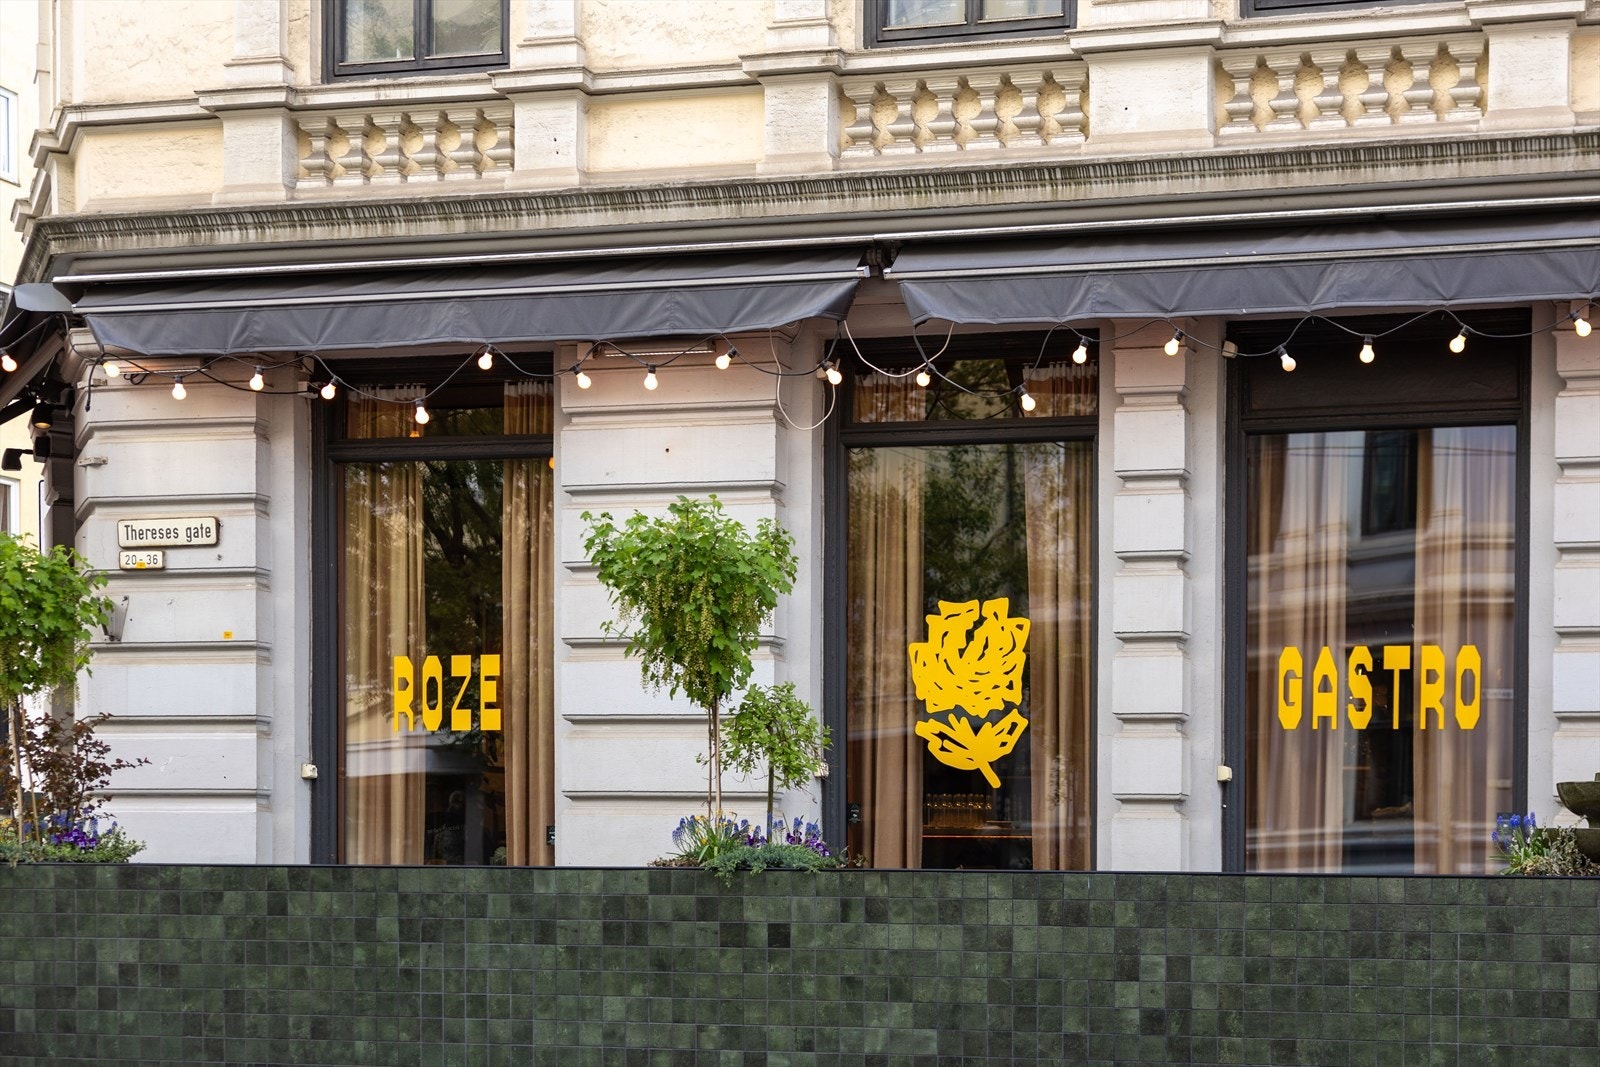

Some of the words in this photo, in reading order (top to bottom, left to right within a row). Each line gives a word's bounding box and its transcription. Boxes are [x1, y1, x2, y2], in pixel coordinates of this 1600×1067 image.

[124, 525, 179, 540] Thereses
[186, 523, 211, 542] gate
[394, 655, 502, 731] ROZE
[1278, 645, 1481, 730] GASTRO
